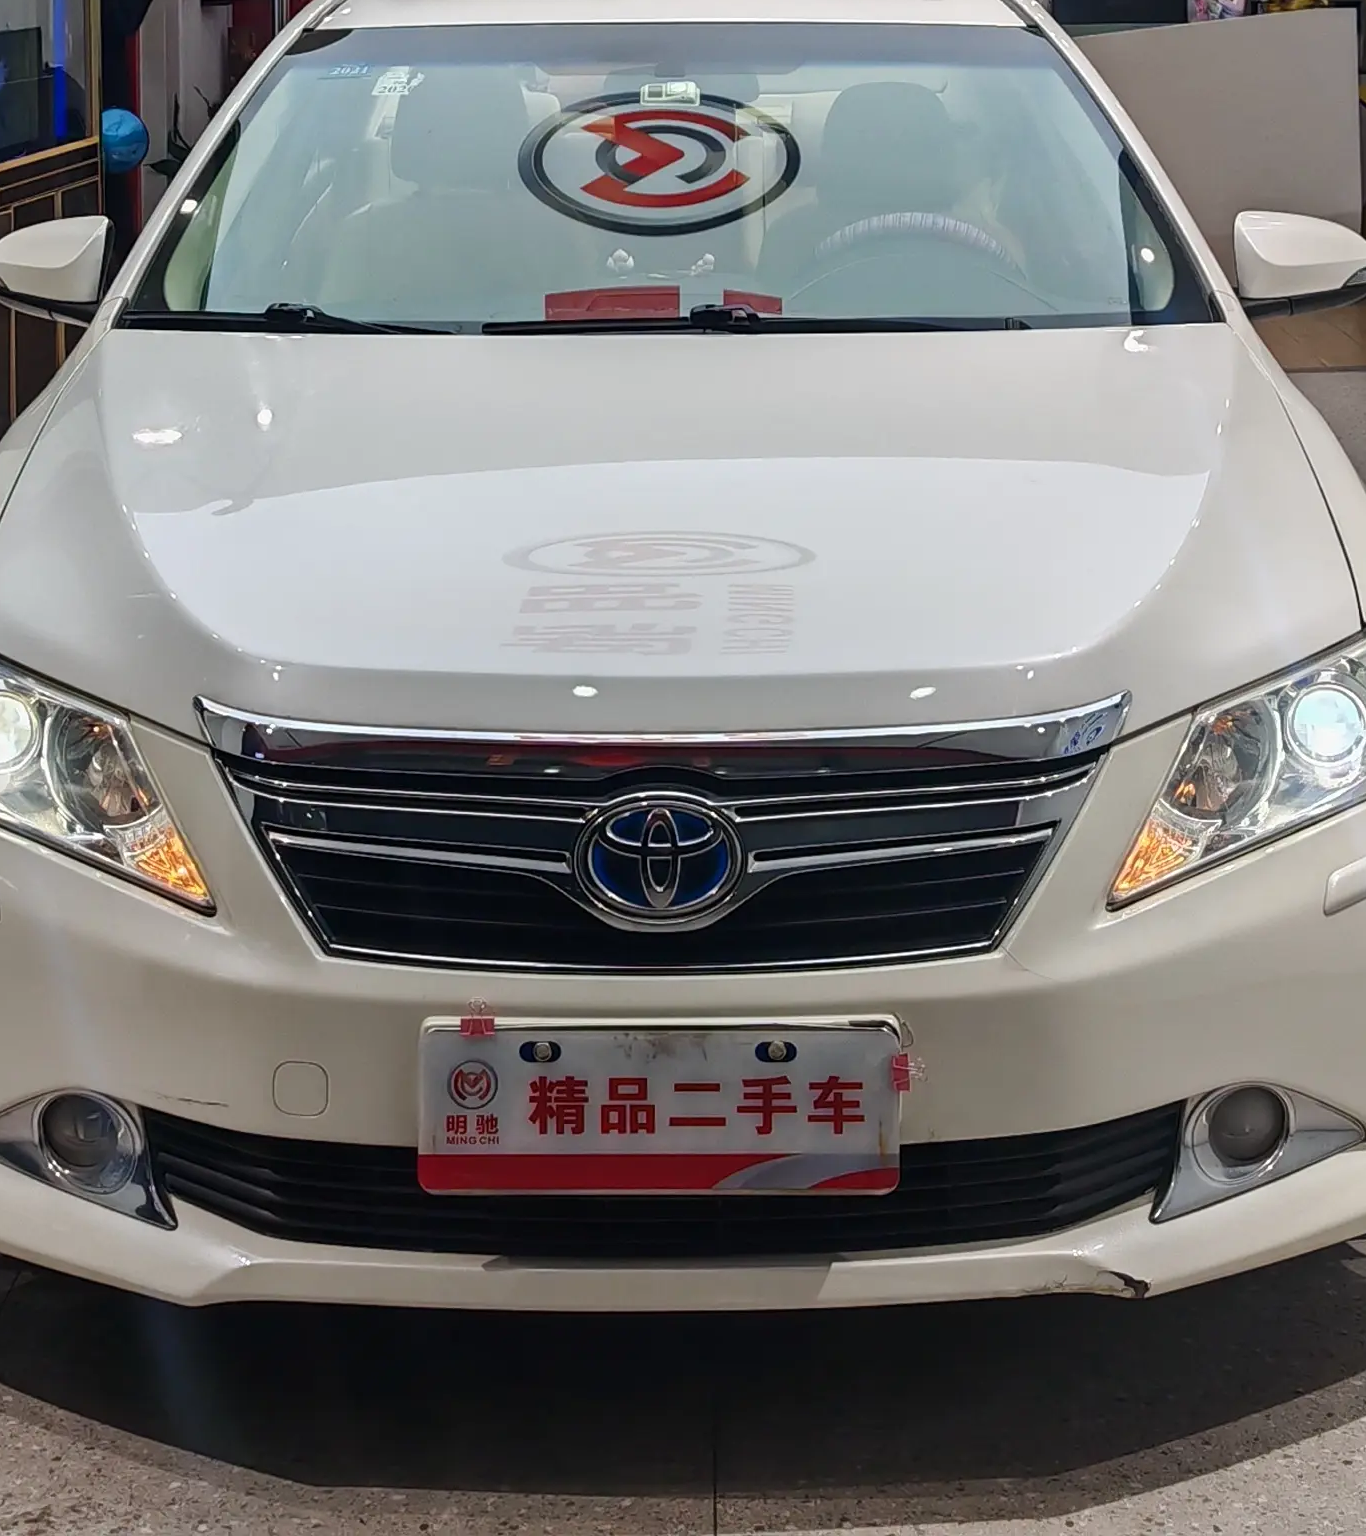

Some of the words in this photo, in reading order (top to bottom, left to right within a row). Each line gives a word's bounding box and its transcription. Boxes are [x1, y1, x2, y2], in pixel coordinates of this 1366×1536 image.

[446, 1114, 500, 1135] 明驰
[528, 1075, 865, 1135] 精品二手车
